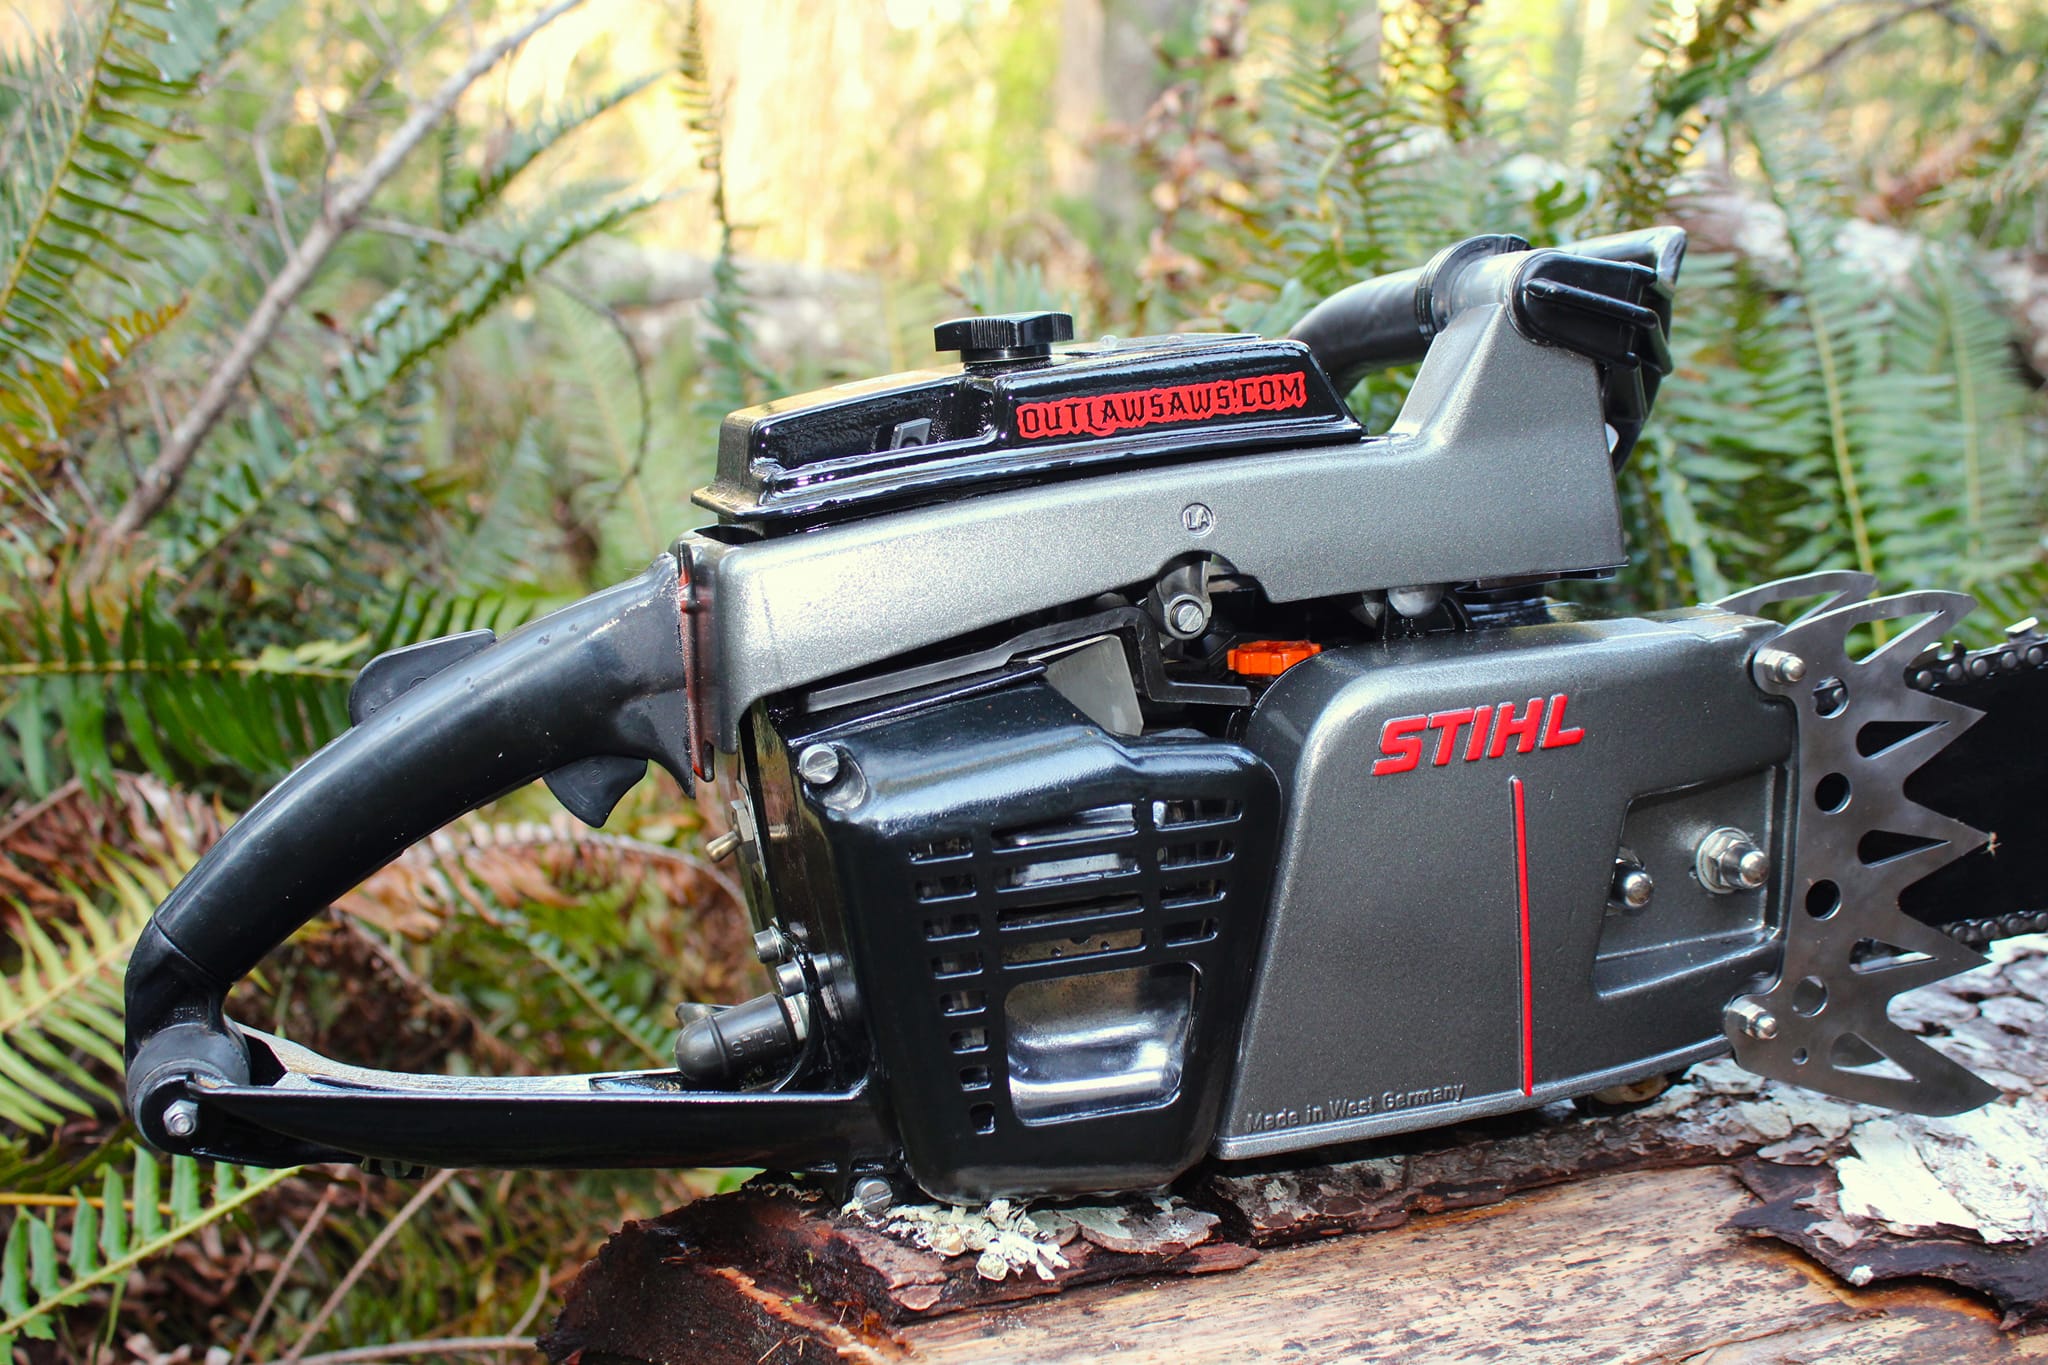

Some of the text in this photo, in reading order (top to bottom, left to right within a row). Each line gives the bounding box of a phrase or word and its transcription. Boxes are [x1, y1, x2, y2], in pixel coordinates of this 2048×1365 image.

[1371, 693, 1586, 776] STIHL
[1247, 1082, 1464, 1133] Made in West Germany
